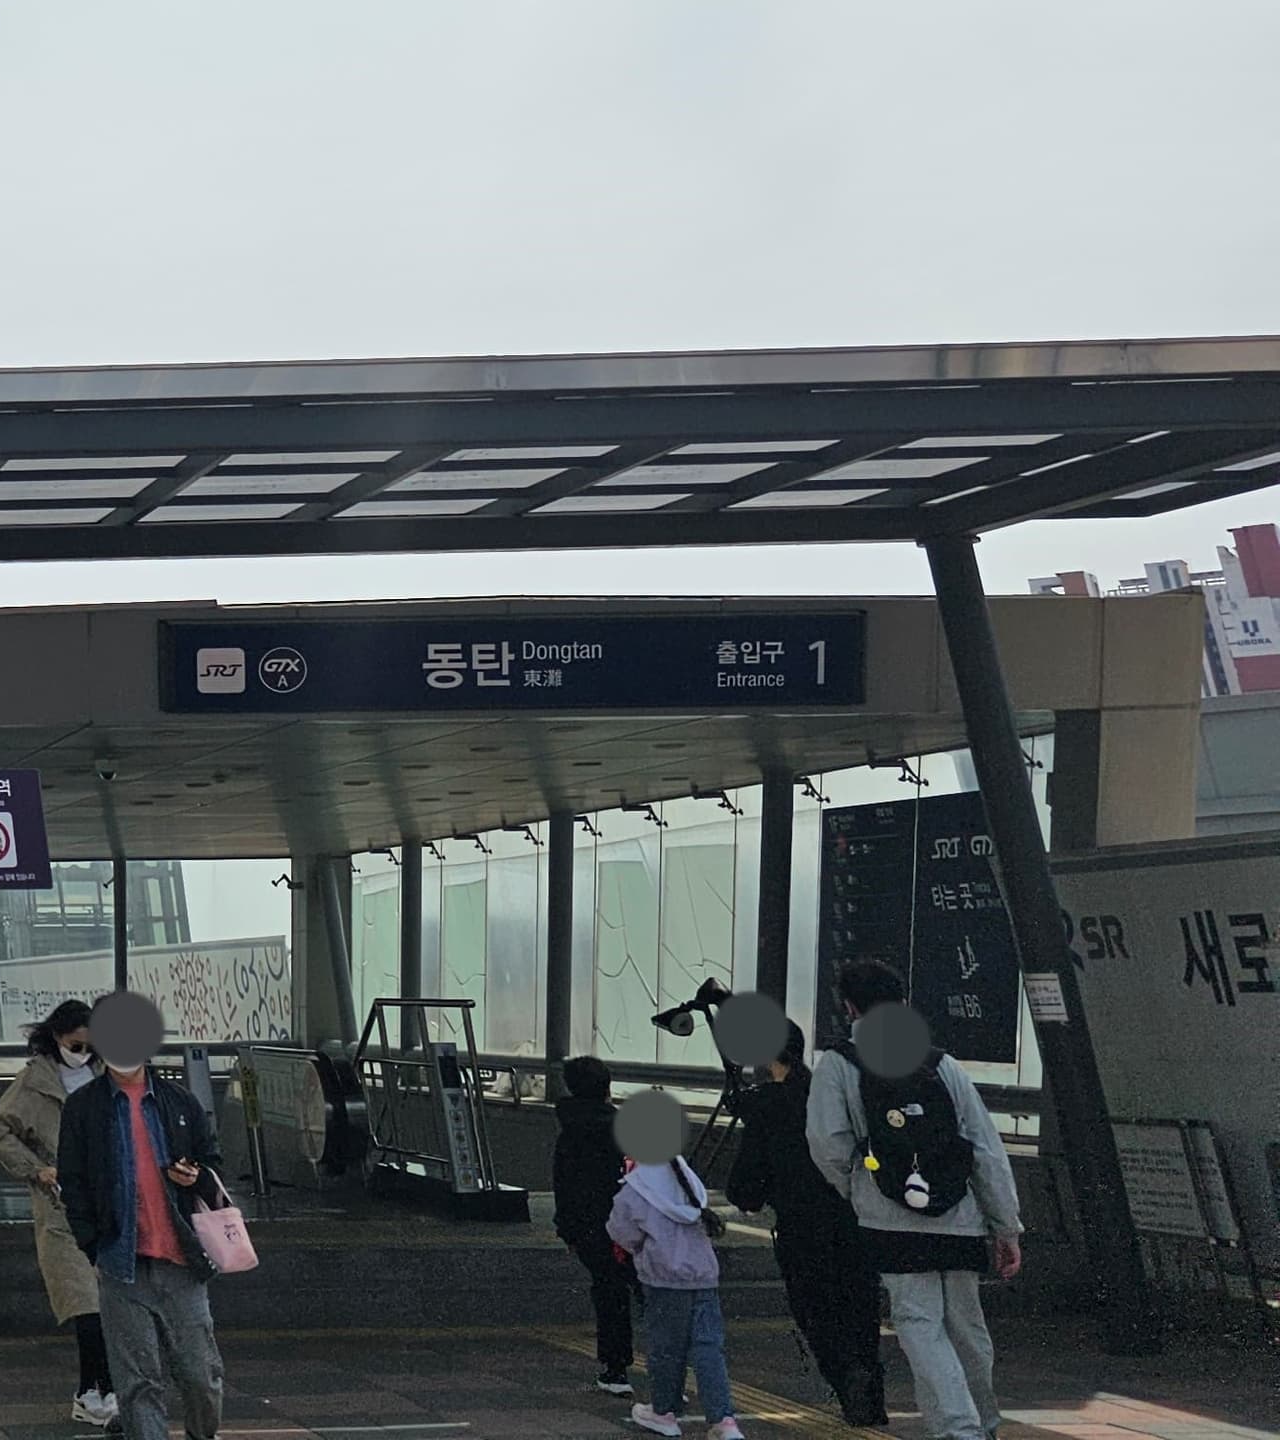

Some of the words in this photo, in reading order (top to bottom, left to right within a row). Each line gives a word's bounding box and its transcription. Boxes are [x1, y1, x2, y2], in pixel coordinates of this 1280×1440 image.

[522, 641, 602, 663] Dongtan
[715, 640, 785, 664] 출입구
[808, 640, 826, 685] 1
[200, 664, 242, 677] SRT
[264, 658, 300, 672] GTX
[422, 641, 515, 689] 동탄
[277, 674, 289, 688] A
[523, 669, 563, 687] 東灘
[717, 672, 785, 687] Entrance
[931, 884, 958, 911] 타는
[1080, 915, 1130, 959] SR
[963, 993, 982, 1018] B6
